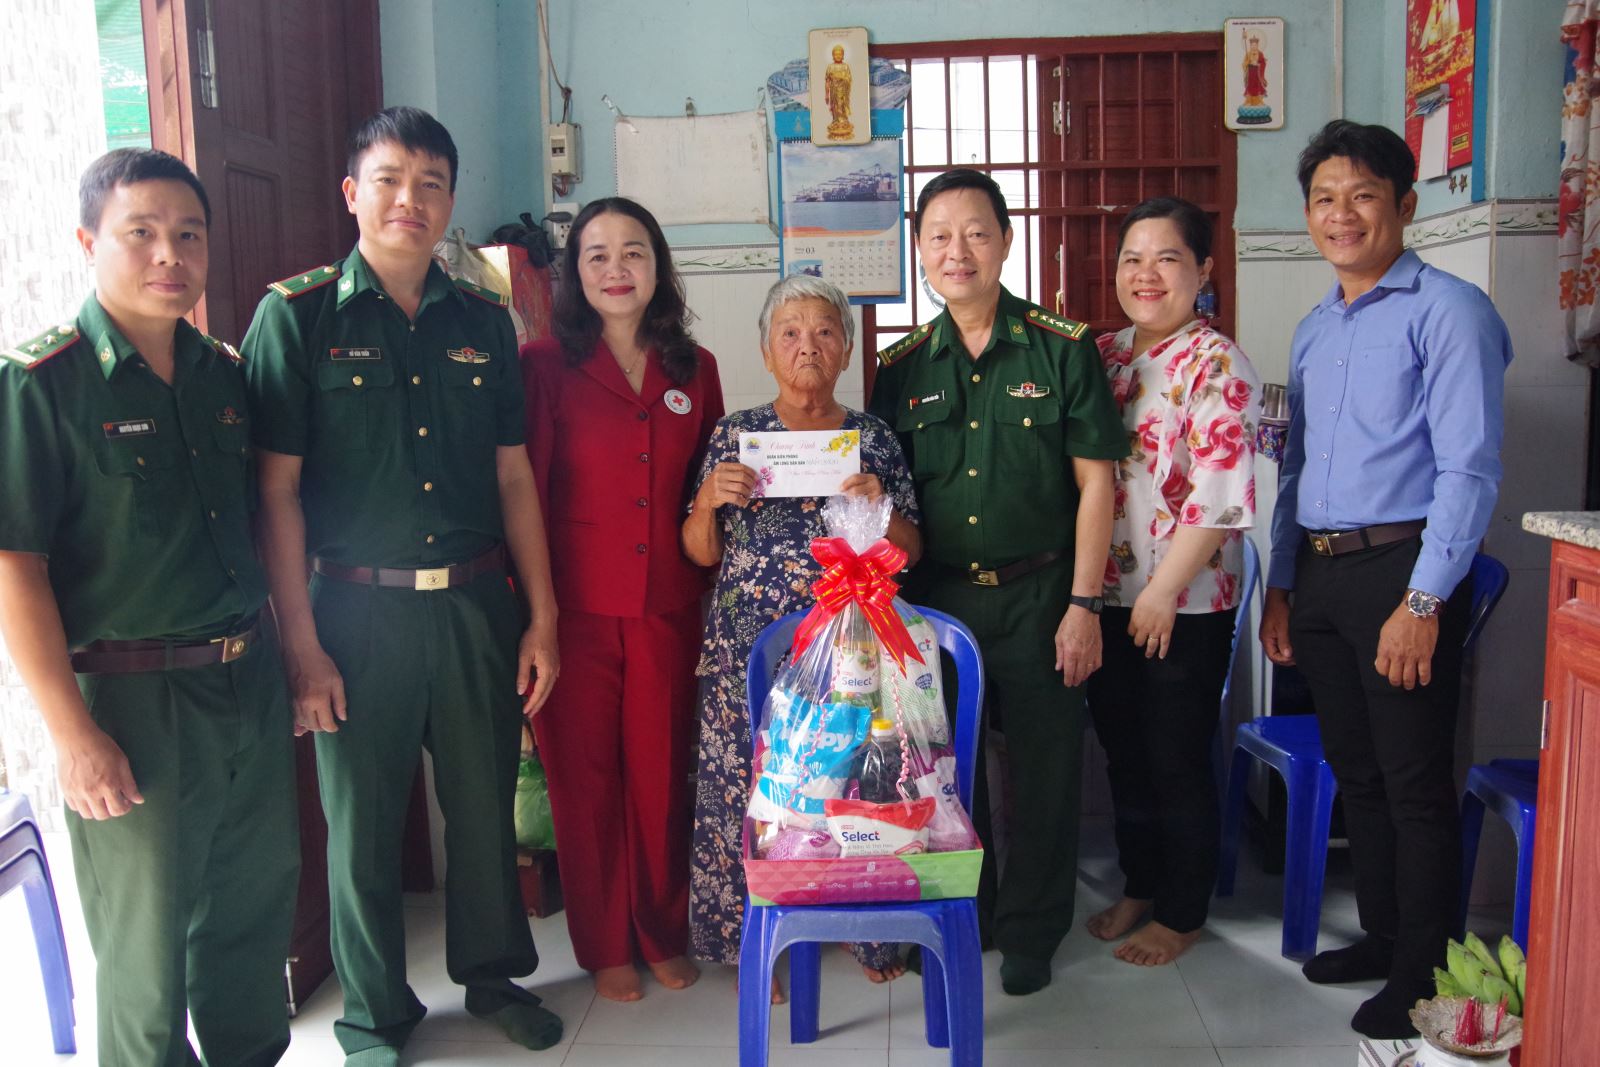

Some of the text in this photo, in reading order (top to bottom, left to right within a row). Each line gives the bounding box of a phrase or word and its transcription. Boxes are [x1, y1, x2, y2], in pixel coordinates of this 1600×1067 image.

[805, 247, 816, 255] 03
[842, 677, 872, 687] Select
[841, 831, 880, 841] Select
